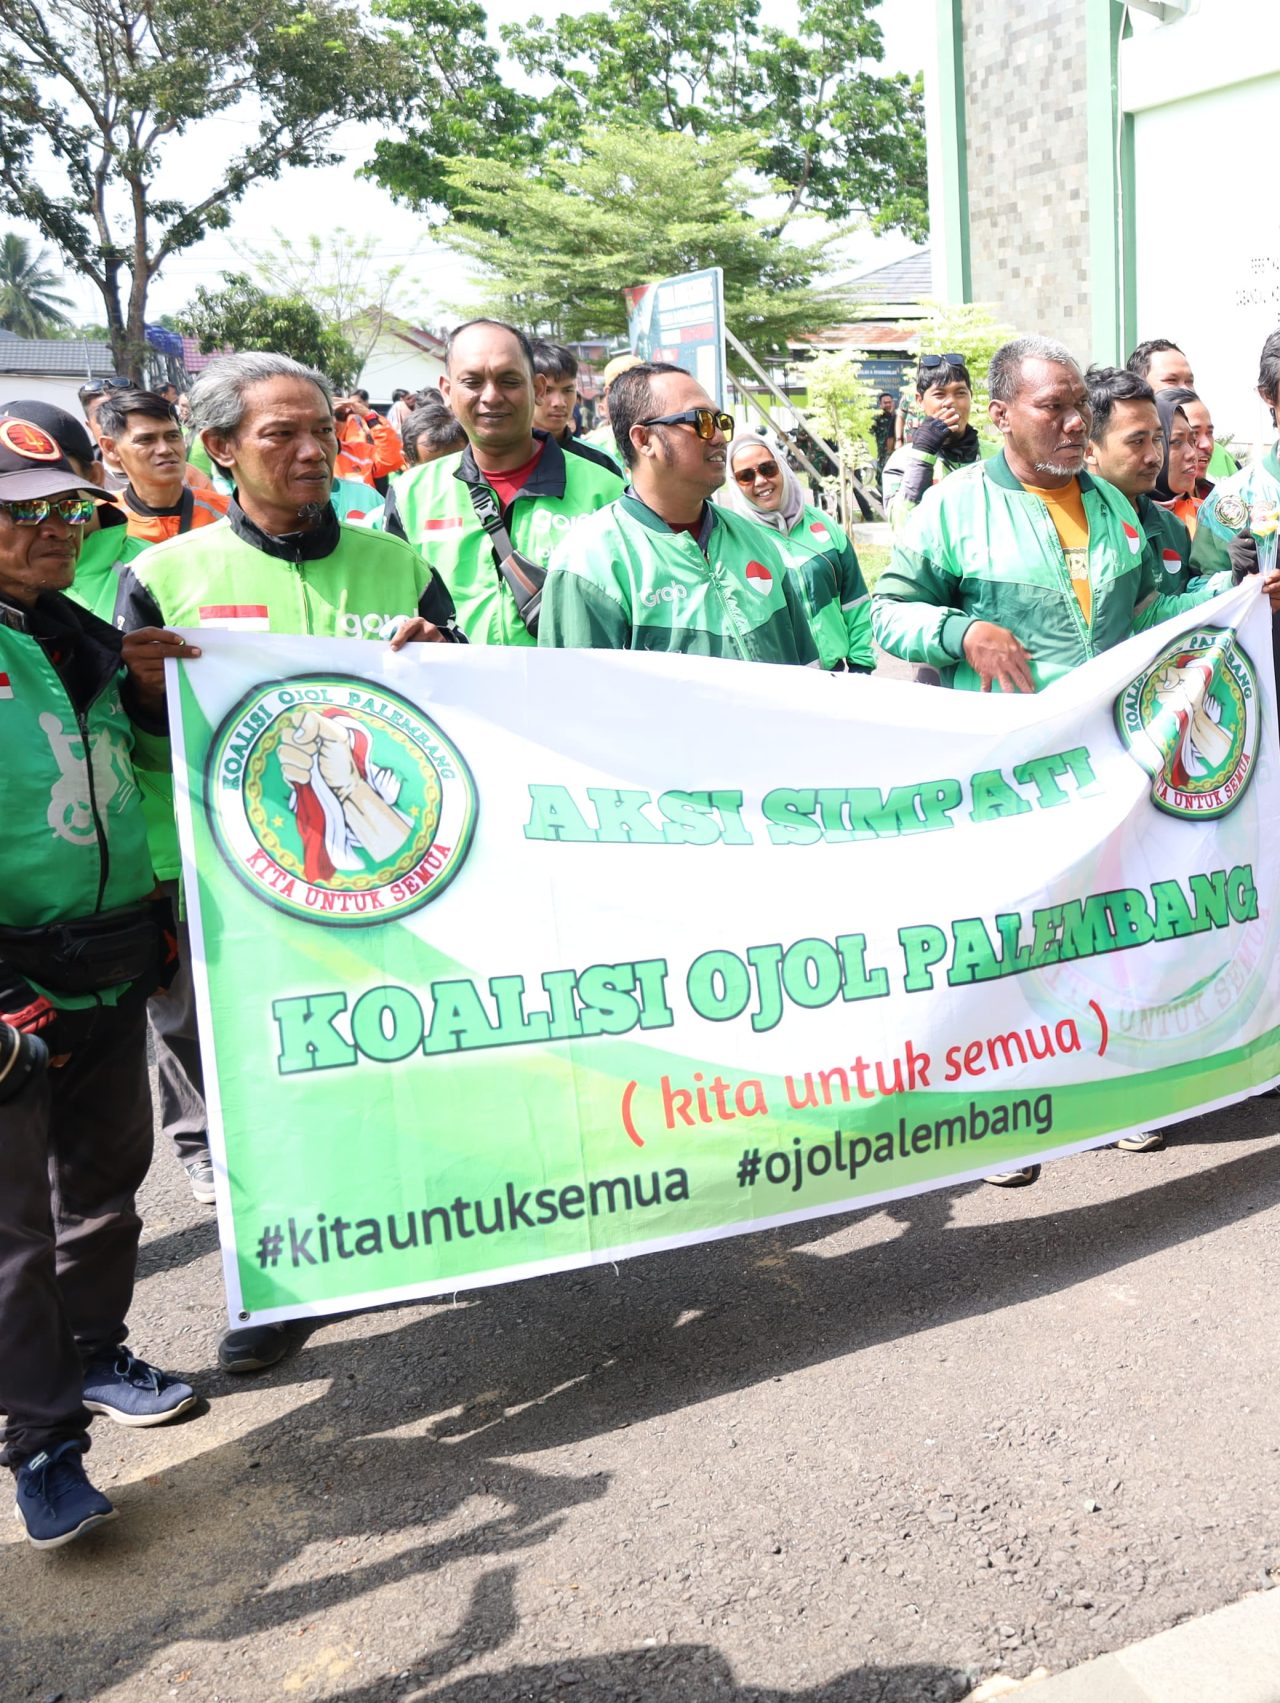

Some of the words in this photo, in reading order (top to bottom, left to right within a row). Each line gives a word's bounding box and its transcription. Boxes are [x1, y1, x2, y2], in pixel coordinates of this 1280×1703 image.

[640, 580, 687, 607] Grab
[222, 704, 273, 791] KOALISI
[278, 689, 333, 705] OJOL
[347, 692, 456, 780] PALEMBANG
[1174, 790, 1223, 809] UNTUK
[1224, 752, 1250, 798] SEMUA
[523, 782, 753, 845] AKSI
[762, 746, 1104, 846] SIMPATI
[246, 847, 293, 899] KITA
[305, 887, 385, 912] UNTUK
[393, 843, 451, 903] SEMUA
[272, 958, 674, 1075] KOALISI
[687, 933, 889, 1032] OJOL
[898, 864, 1259, 993] PALEMBANG
[660, 1070, 768, 1130] kita
[786, 1041, 930, 1111] untuk
[944, 1018, 1082, 1081] semua
[256, 1166, 689, 1270] #kitauntuksemua
[737, 1093, 1054, 1192] #ojolpalembang
